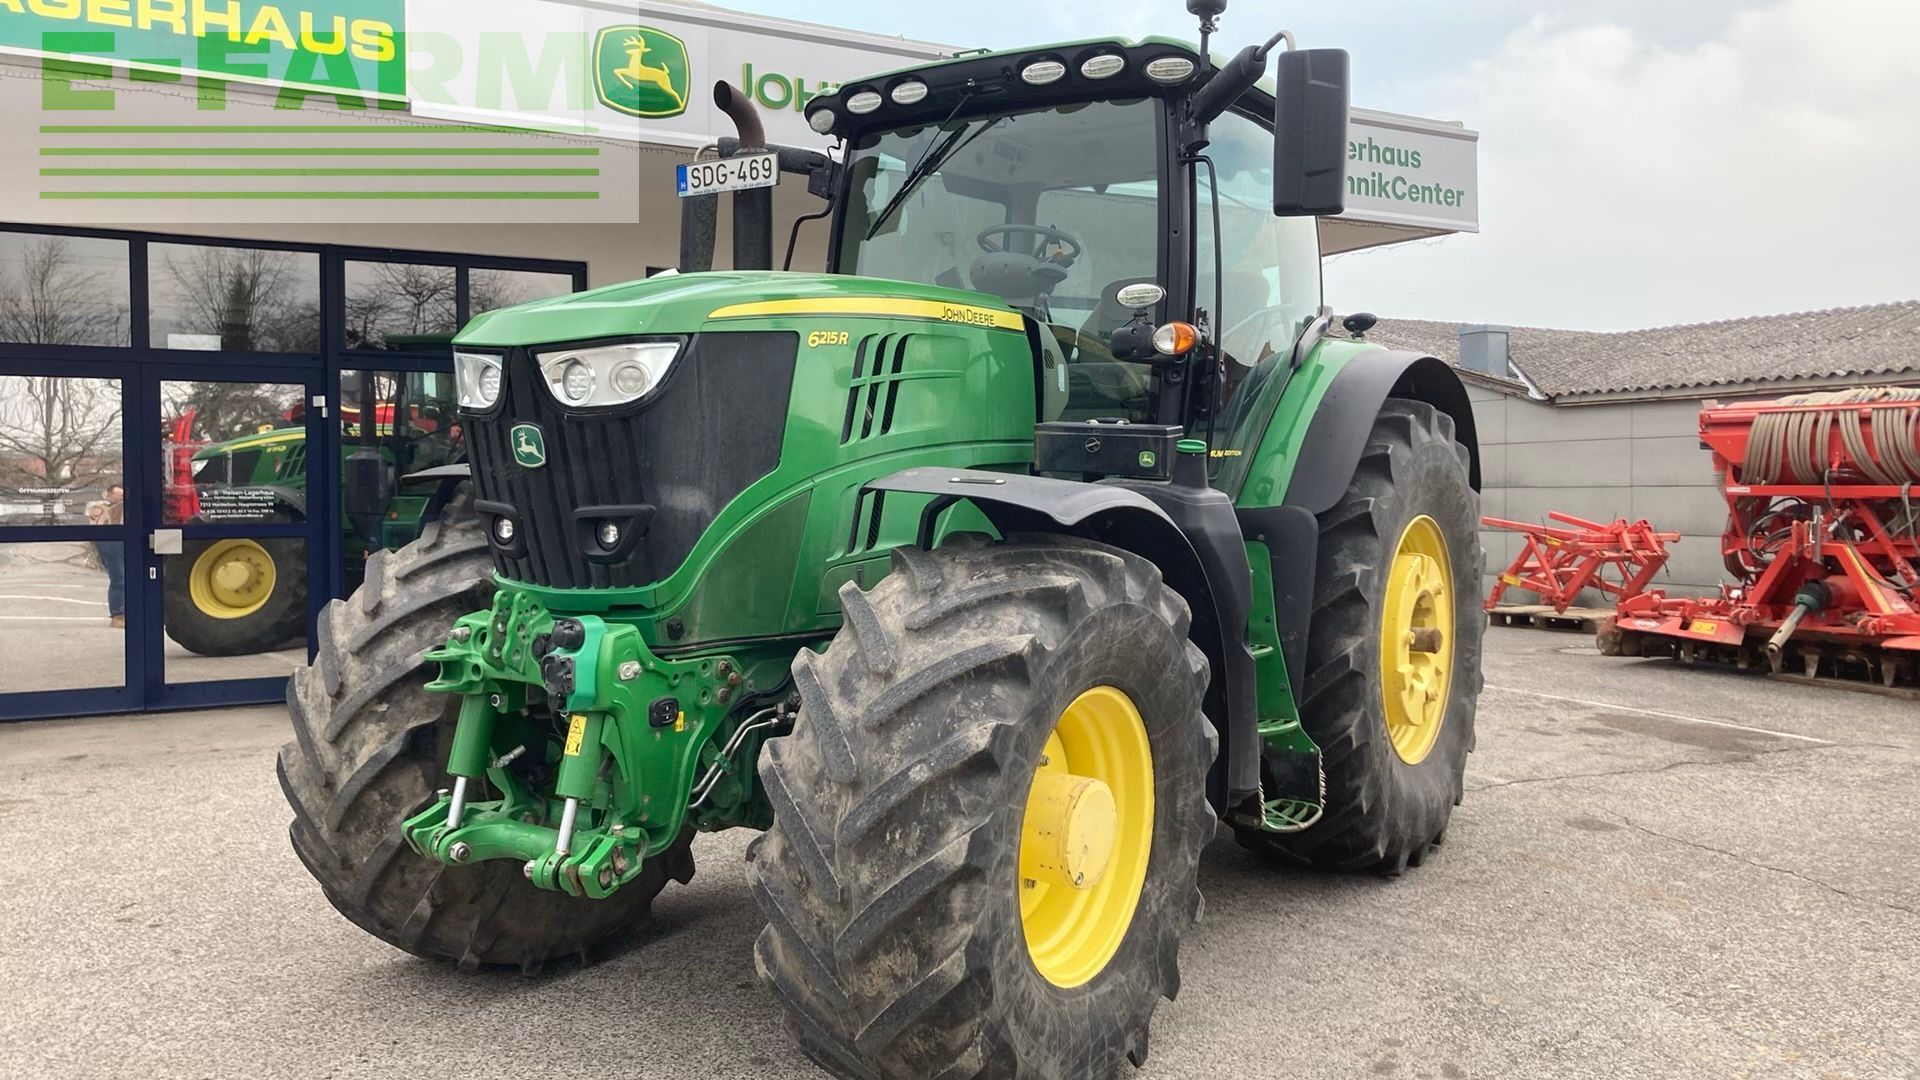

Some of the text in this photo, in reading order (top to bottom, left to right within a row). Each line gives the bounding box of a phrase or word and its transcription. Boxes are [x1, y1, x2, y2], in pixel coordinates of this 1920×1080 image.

[0, 0, 397, 61] GERHAUS
[742, 62, 841, 113] JOH
[690, 157, 773, 189] SDG-469
[1348, 137, 1422, 169] erhaus
